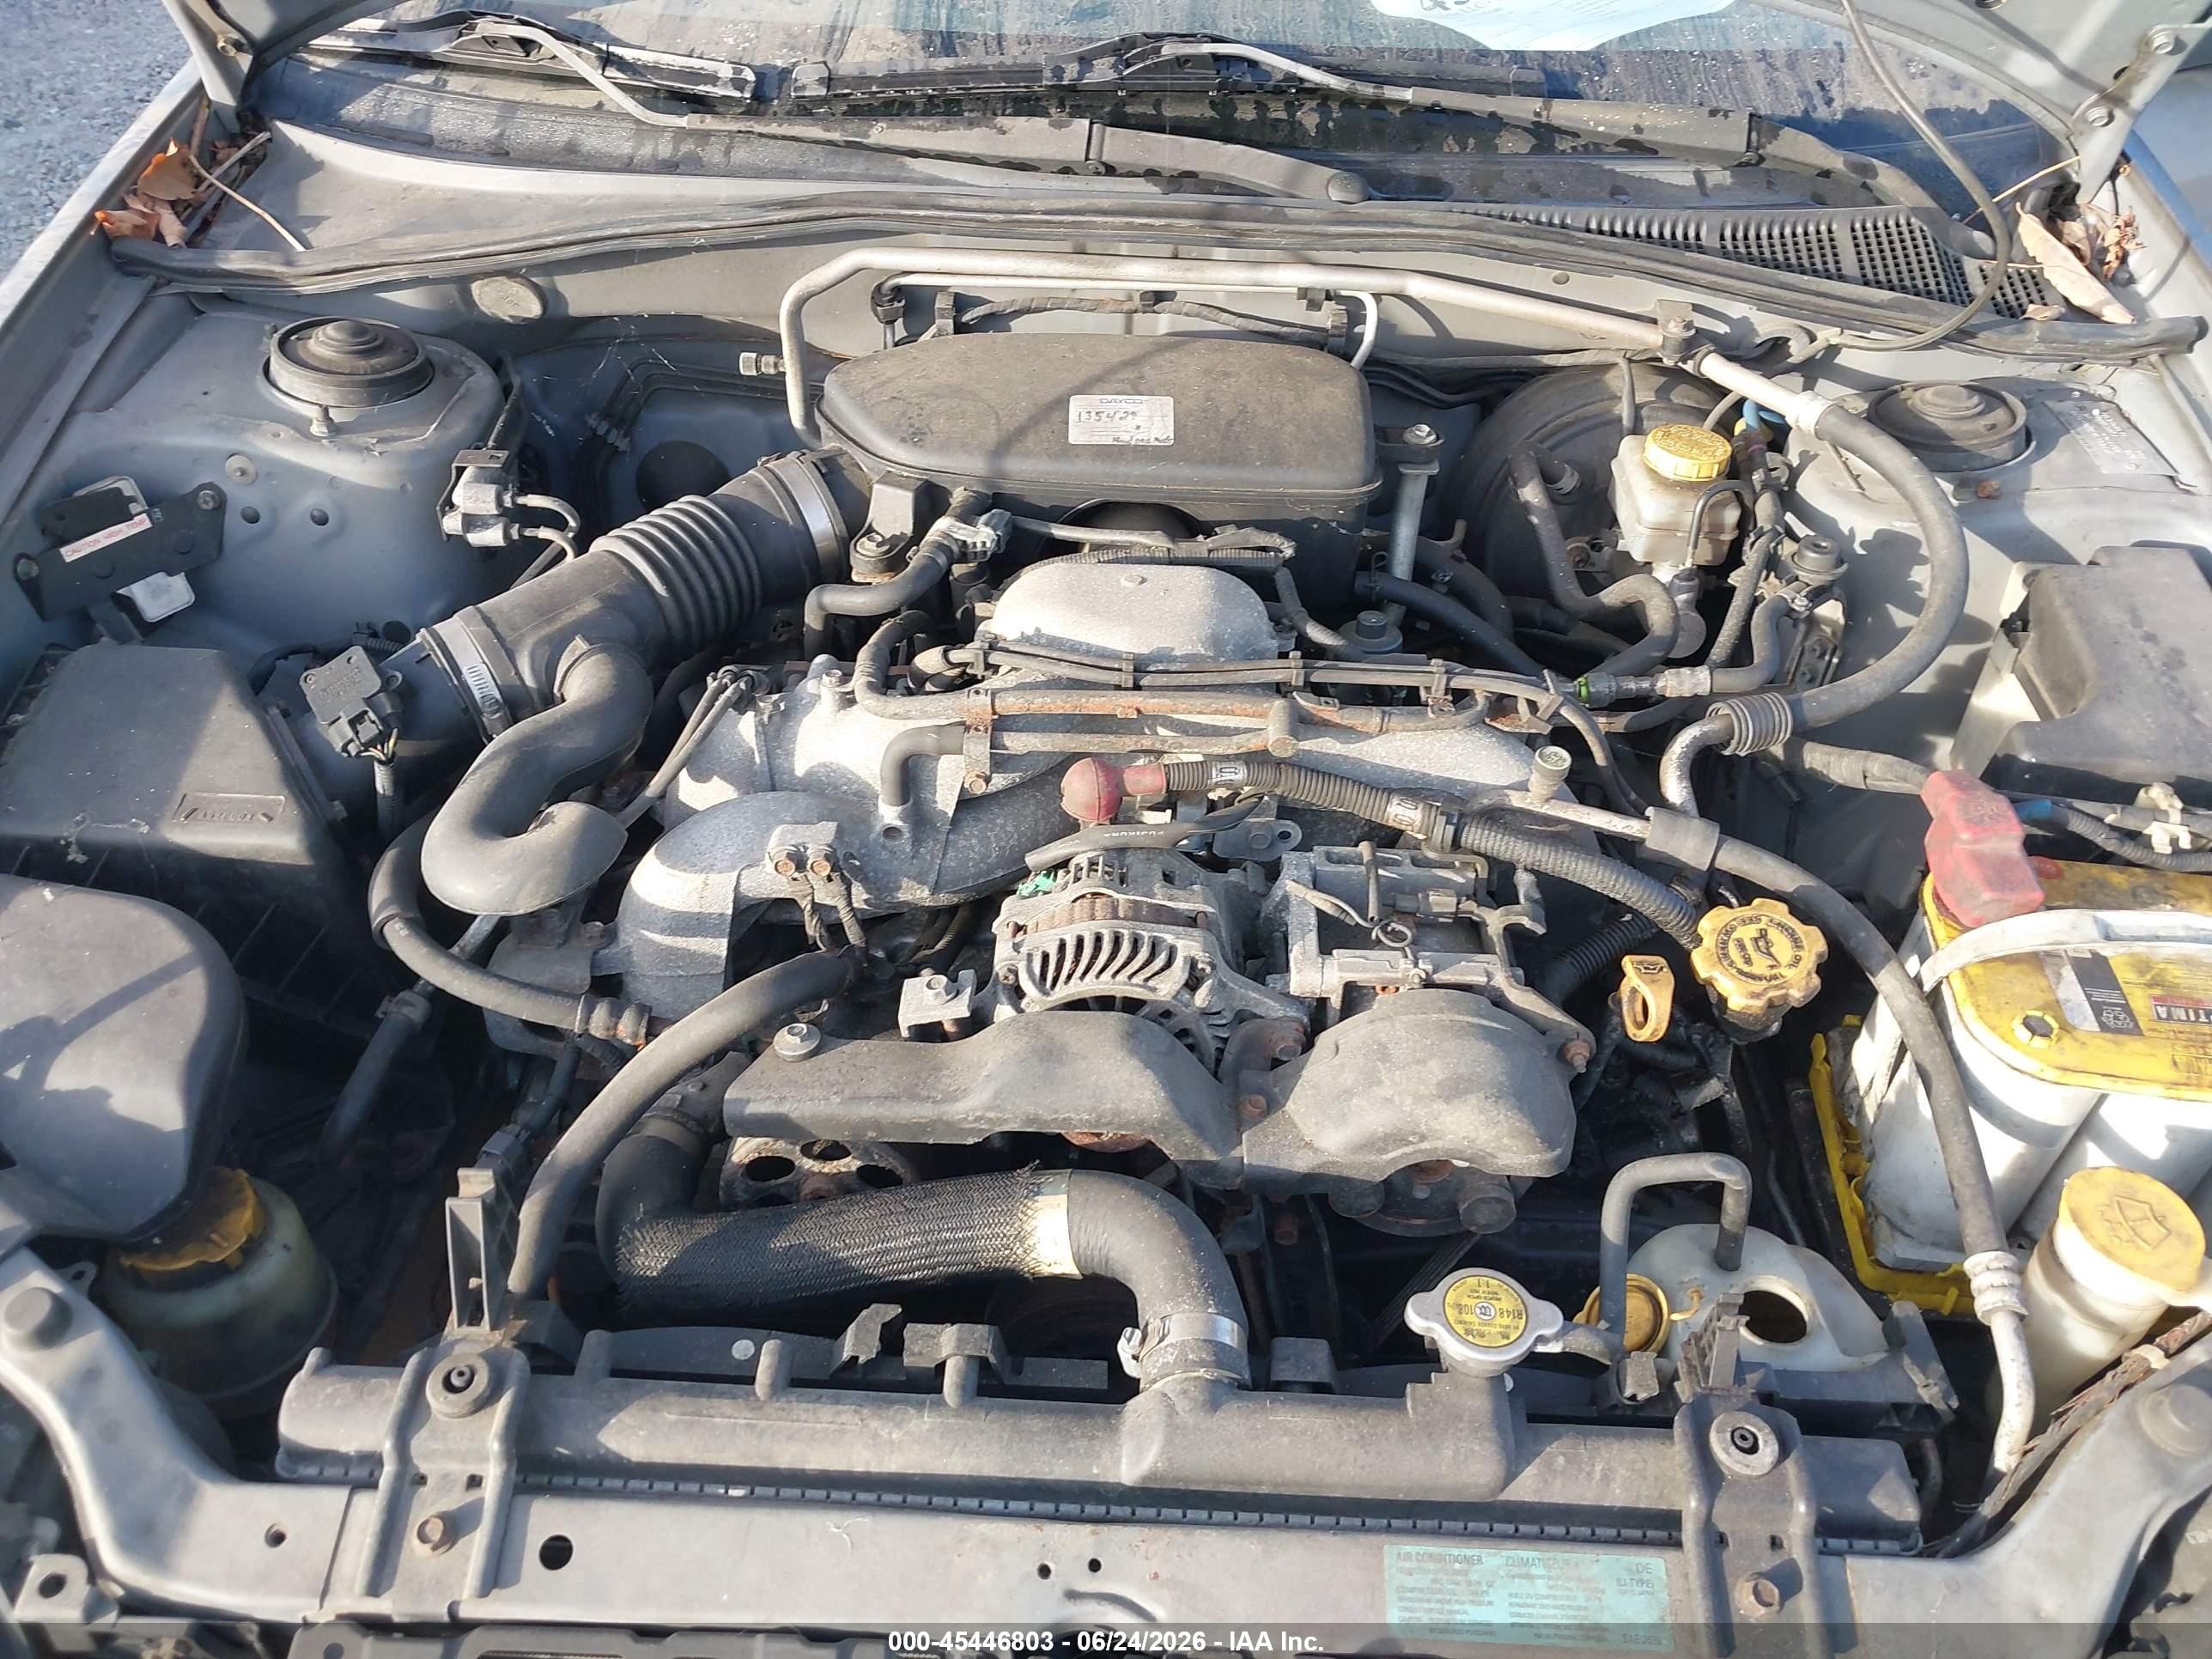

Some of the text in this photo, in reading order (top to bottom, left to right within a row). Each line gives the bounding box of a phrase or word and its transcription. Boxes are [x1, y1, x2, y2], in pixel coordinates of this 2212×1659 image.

[1498, 1307, 1523, 1320] R148
[1397, 1552, 1484, 1565] AIR CONDITIONER
